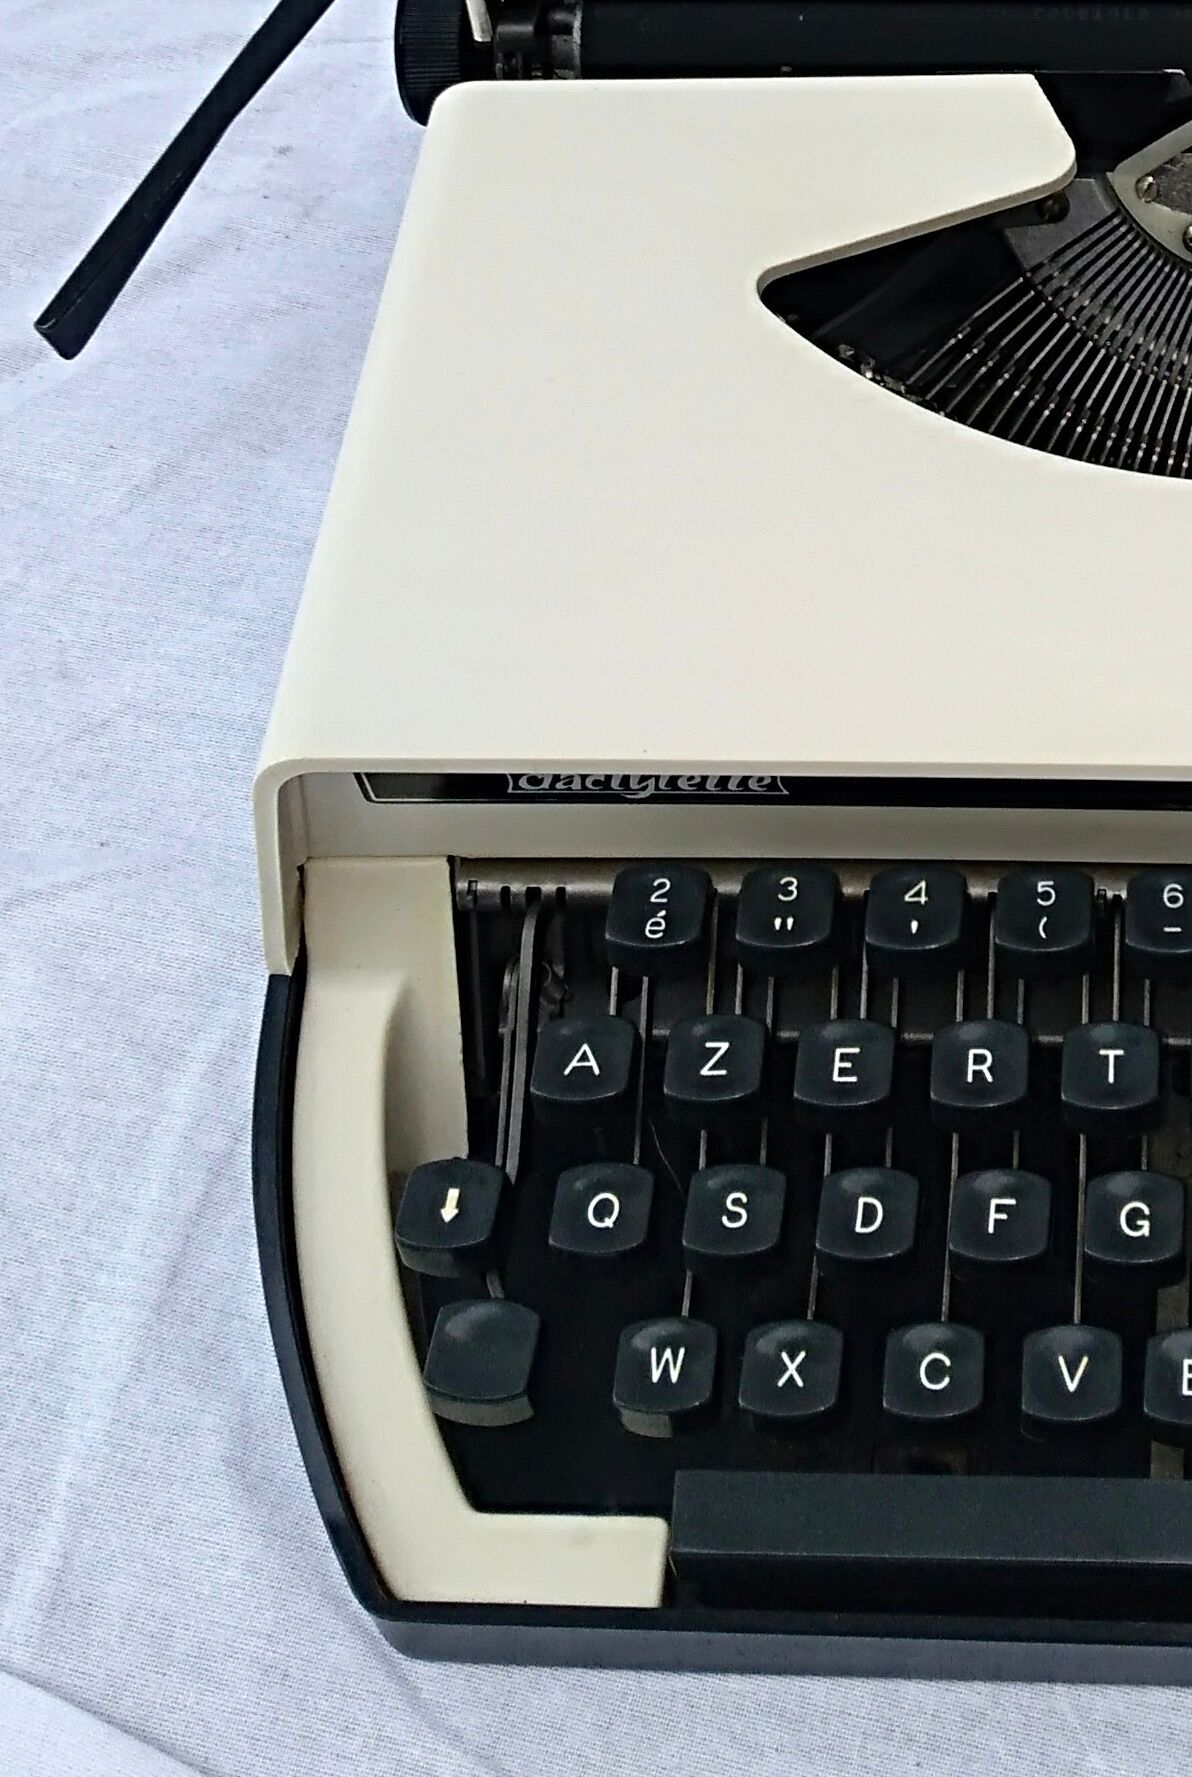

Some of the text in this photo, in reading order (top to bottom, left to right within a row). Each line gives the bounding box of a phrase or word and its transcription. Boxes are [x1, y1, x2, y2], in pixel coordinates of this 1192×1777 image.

[650, 878, 671, 903] 2
[778, 876, 798, 901] 3
[904, 880, 929, 905] 4
[1036, 880, 1056, 906] 5
[1162, 883, 1184, 909] 6
[644, 909, 667, 939] é
[563, 1043, 600, 1076] A
[699, 1041, 730, 1076] Z
[832, 1047, 861, 1083] E
[966, 1048, 994, 1083] R
[1098, 1048, 1125, 1084] T
[587, 1192, 620, 1229] Q
[721, 1191, 748, 1229] S
[854, 1196, 884, 1234] D
[987, 1197, 1017, 1234] F
[1119, 1200, 1150, 1237] G
[650, 1346, 686, 1384] W
[777, 1350, 806, 1388] X
[919, 1352, 951, 1391] C
[1058, 1355, 1089, 1393] V
